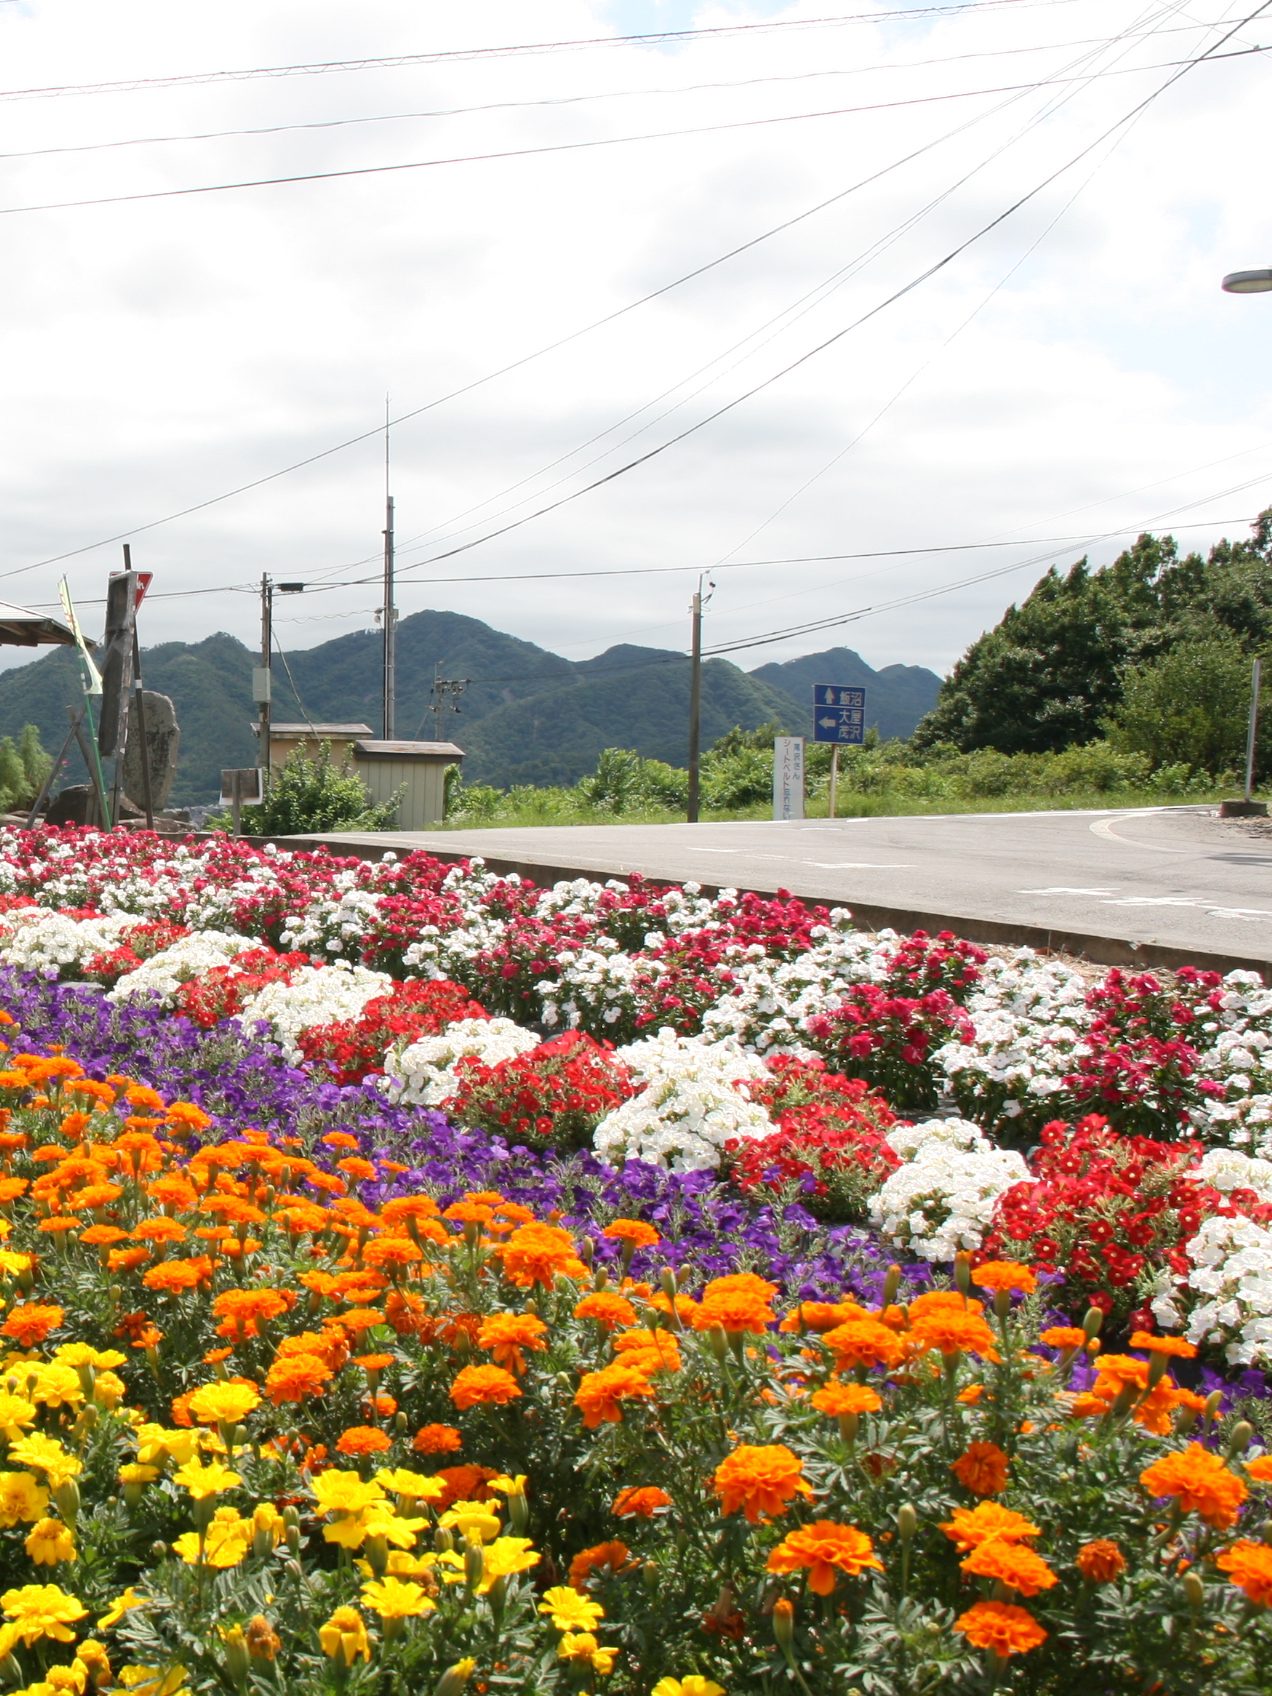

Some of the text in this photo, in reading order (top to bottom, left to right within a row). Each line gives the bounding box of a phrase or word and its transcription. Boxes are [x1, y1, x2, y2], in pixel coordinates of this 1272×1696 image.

[839, 691, 862, 706] 飯沼
[839, 709, 862, 725] 大屋
[838, 725, 861, 740] 茂沢
